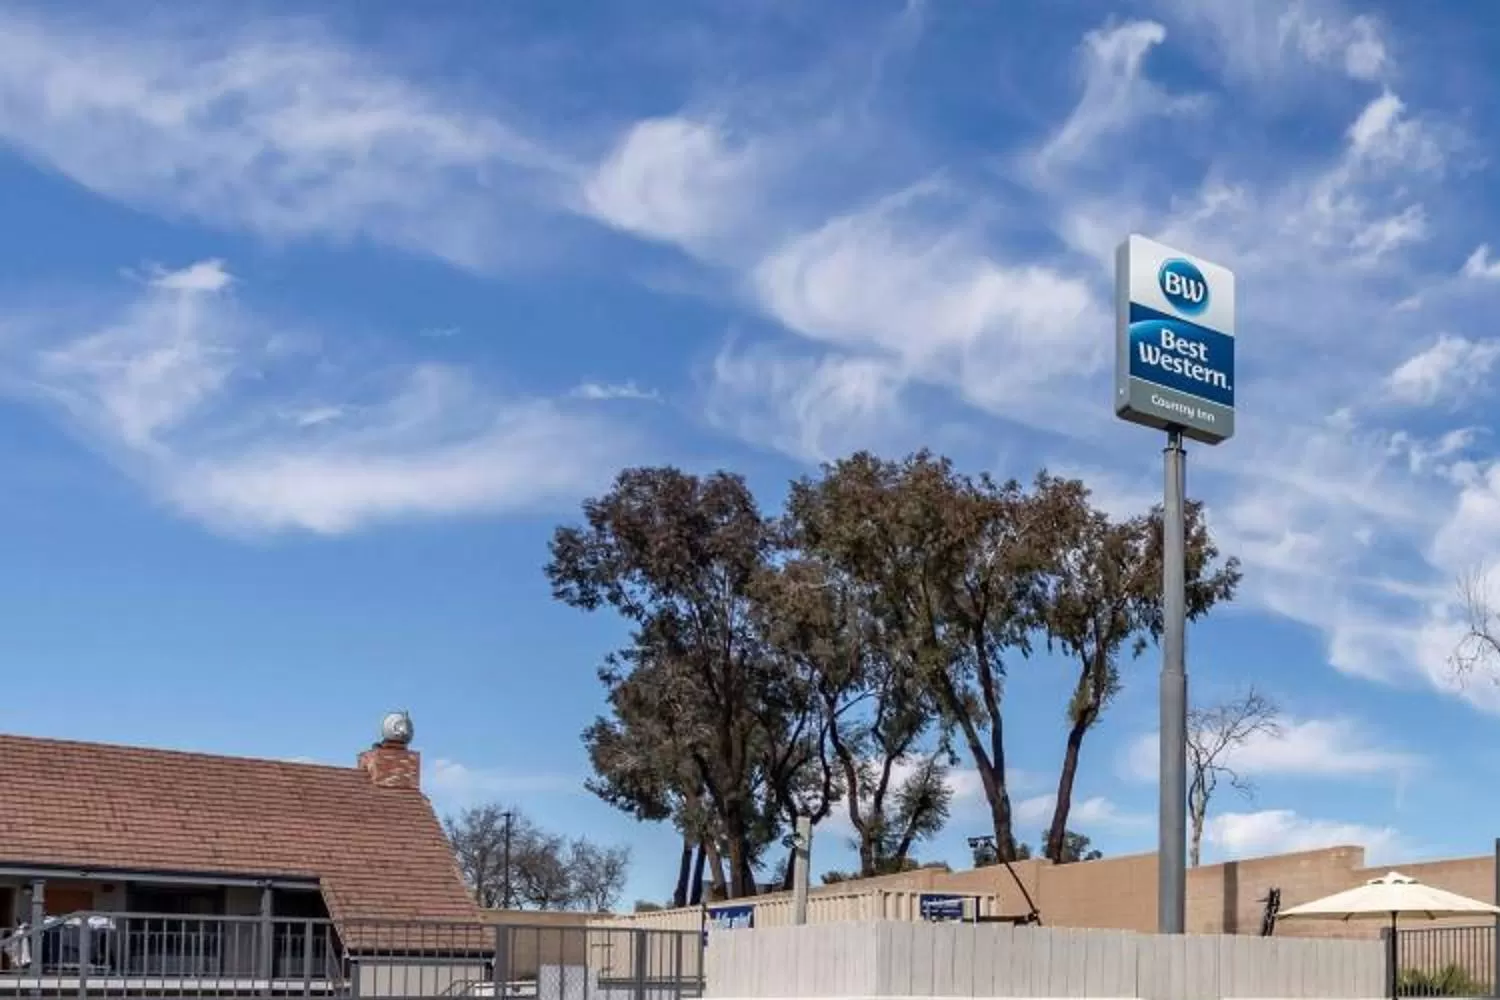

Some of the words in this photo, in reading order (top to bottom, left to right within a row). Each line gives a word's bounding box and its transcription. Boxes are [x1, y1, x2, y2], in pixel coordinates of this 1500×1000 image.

[1165, 271, 1204, 303] BW
[1161, 328, 1208, 363] Best
[1151, 395, 1195, 418] Country
[1196, 408, 1215, 423] Inn
